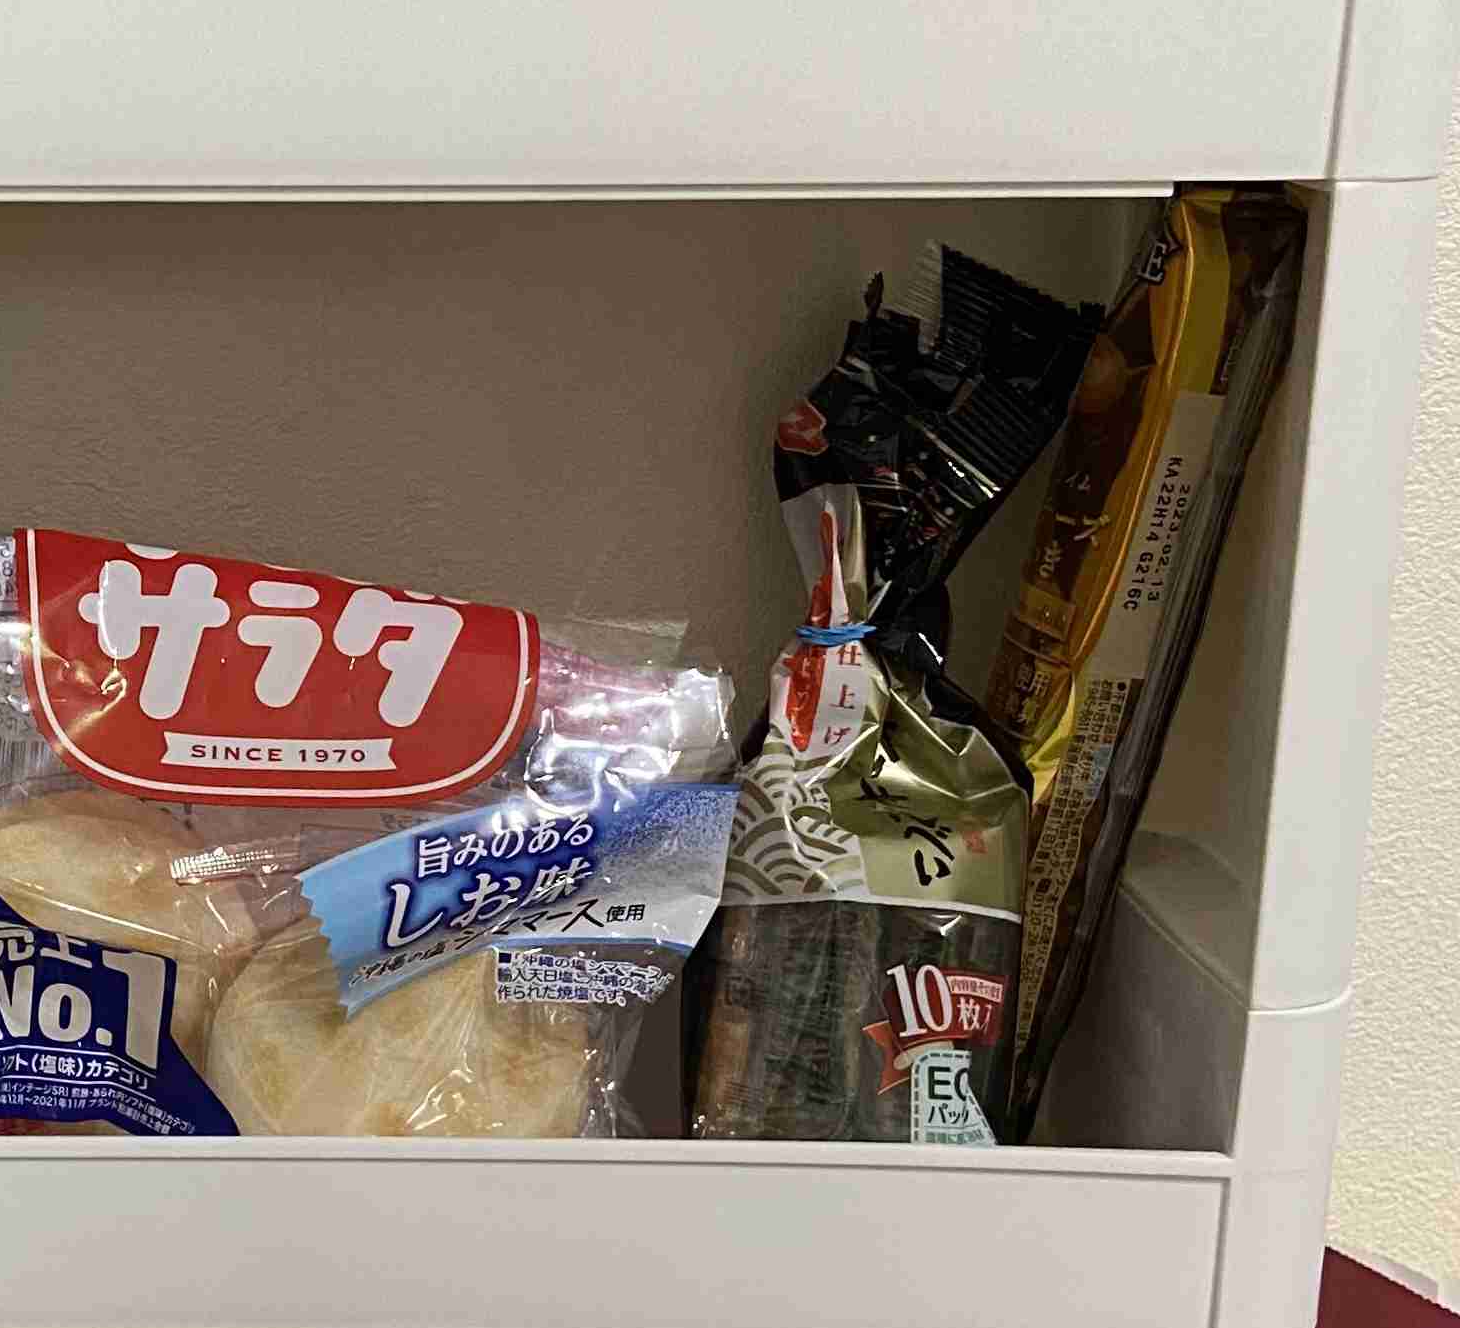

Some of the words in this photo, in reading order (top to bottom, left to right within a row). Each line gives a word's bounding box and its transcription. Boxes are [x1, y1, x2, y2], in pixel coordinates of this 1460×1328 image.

[190, 744, 283, 763] SINCE
[298, 748, 367, 764] 1970
[417, 812, 595, 879] 旨みのある
[606, 903, 646, 923] 使用
[886, 963, 954, 1038] 10
